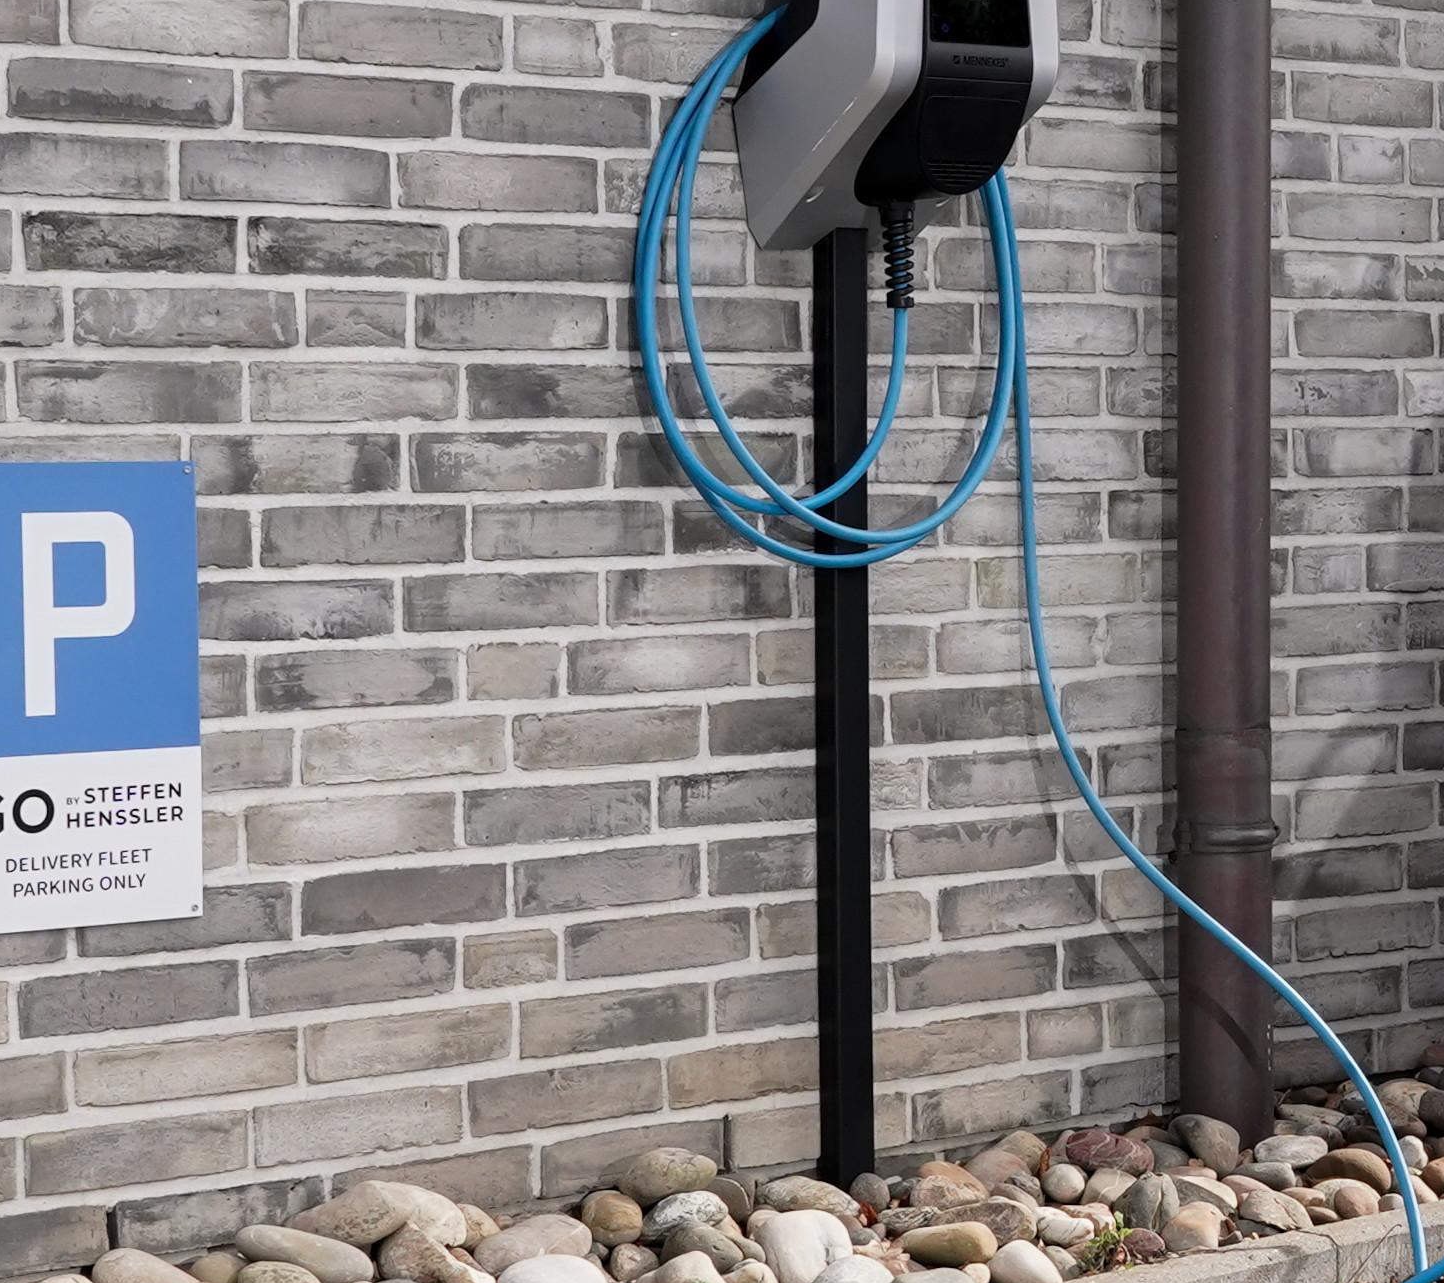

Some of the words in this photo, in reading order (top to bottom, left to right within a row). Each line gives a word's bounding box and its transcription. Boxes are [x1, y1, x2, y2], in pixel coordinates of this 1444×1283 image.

[21, 511, 136, 717] P
[66, 797, 81, 806] BY
[84, 782, 182, 805] STEFFEN
[66, 805, 184, 829] HENSSLER
[5, 851, 94, 873] DELIVERY
[98, 848, 153, 866] FLEET
[13, 877, 95, 898] PARKING
[99, 873, 146, 891] ONLY
